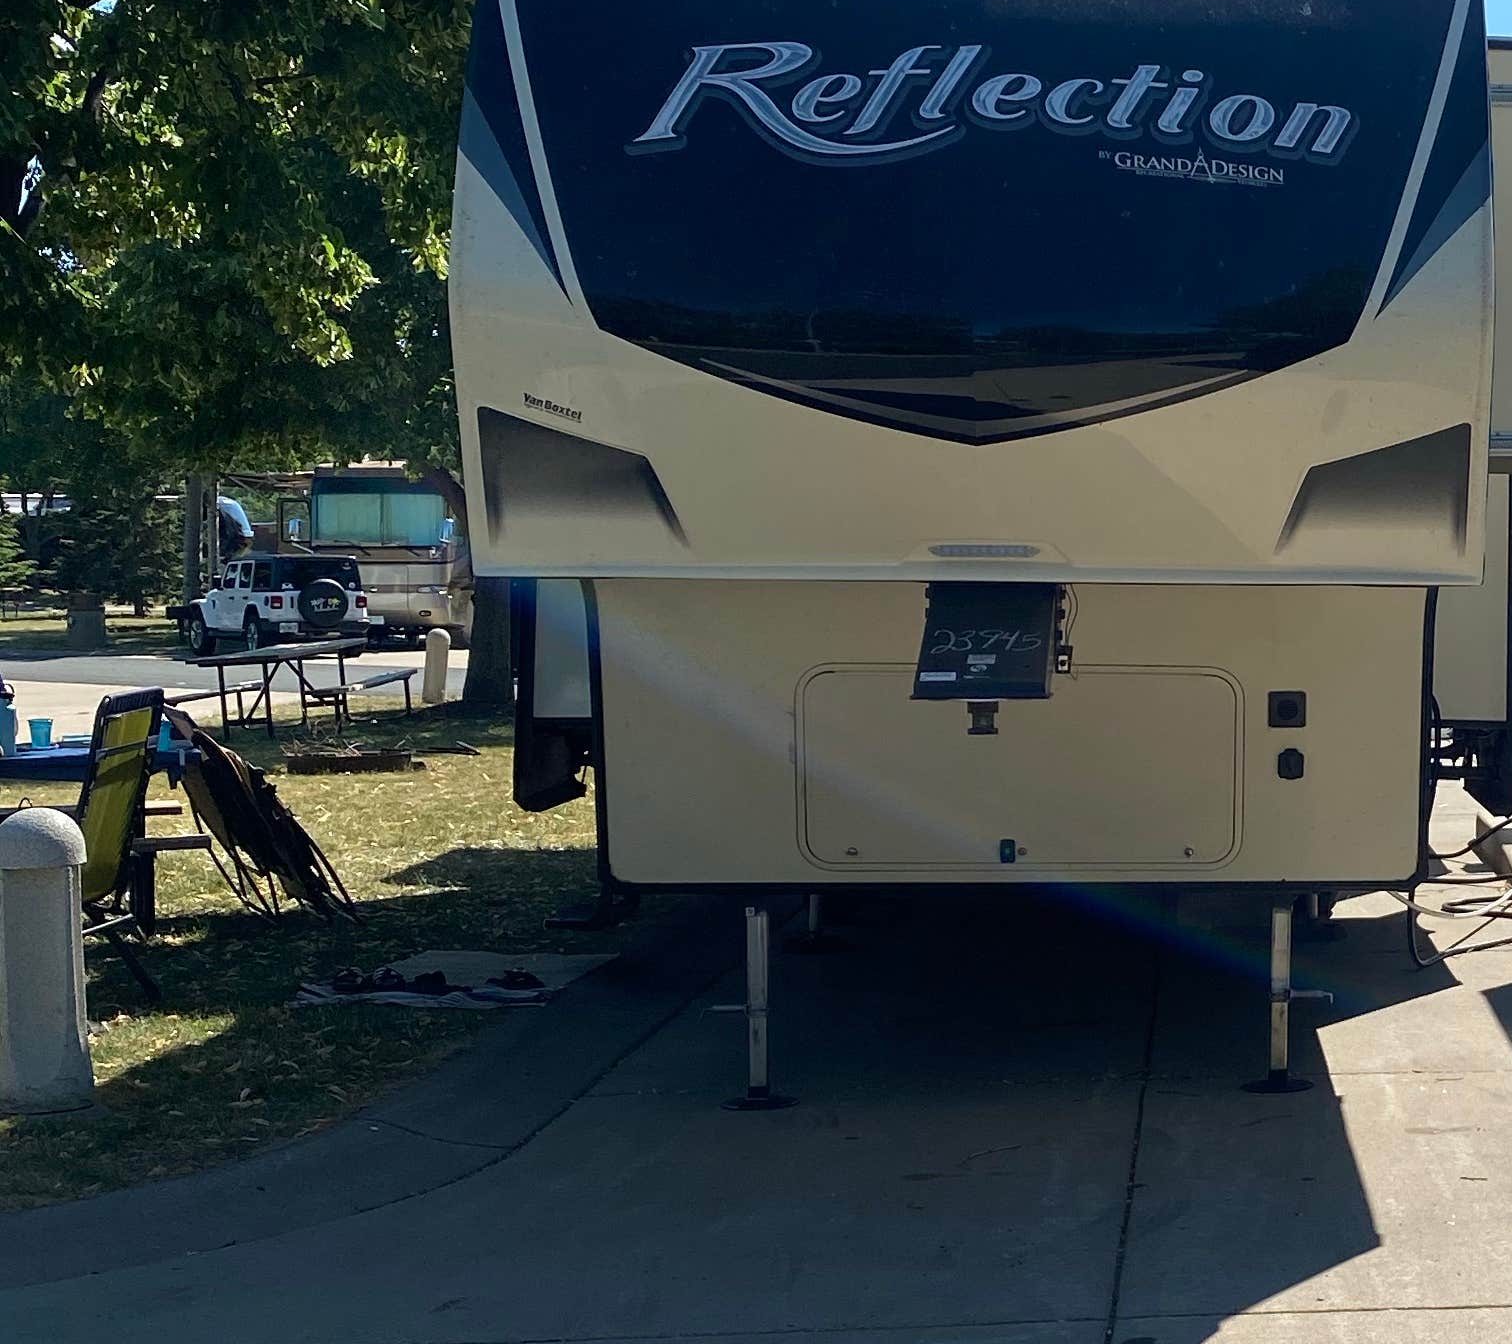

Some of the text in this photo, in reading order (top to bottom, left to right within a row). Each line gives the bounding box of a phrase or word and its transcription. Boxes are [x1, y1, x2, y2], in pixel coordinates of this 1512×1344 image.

[632, 40, 1352, 155] Reflection
[1114, 152, 1192, 172] GRAND
[1211, 159, 1284, 183] DESIGN
